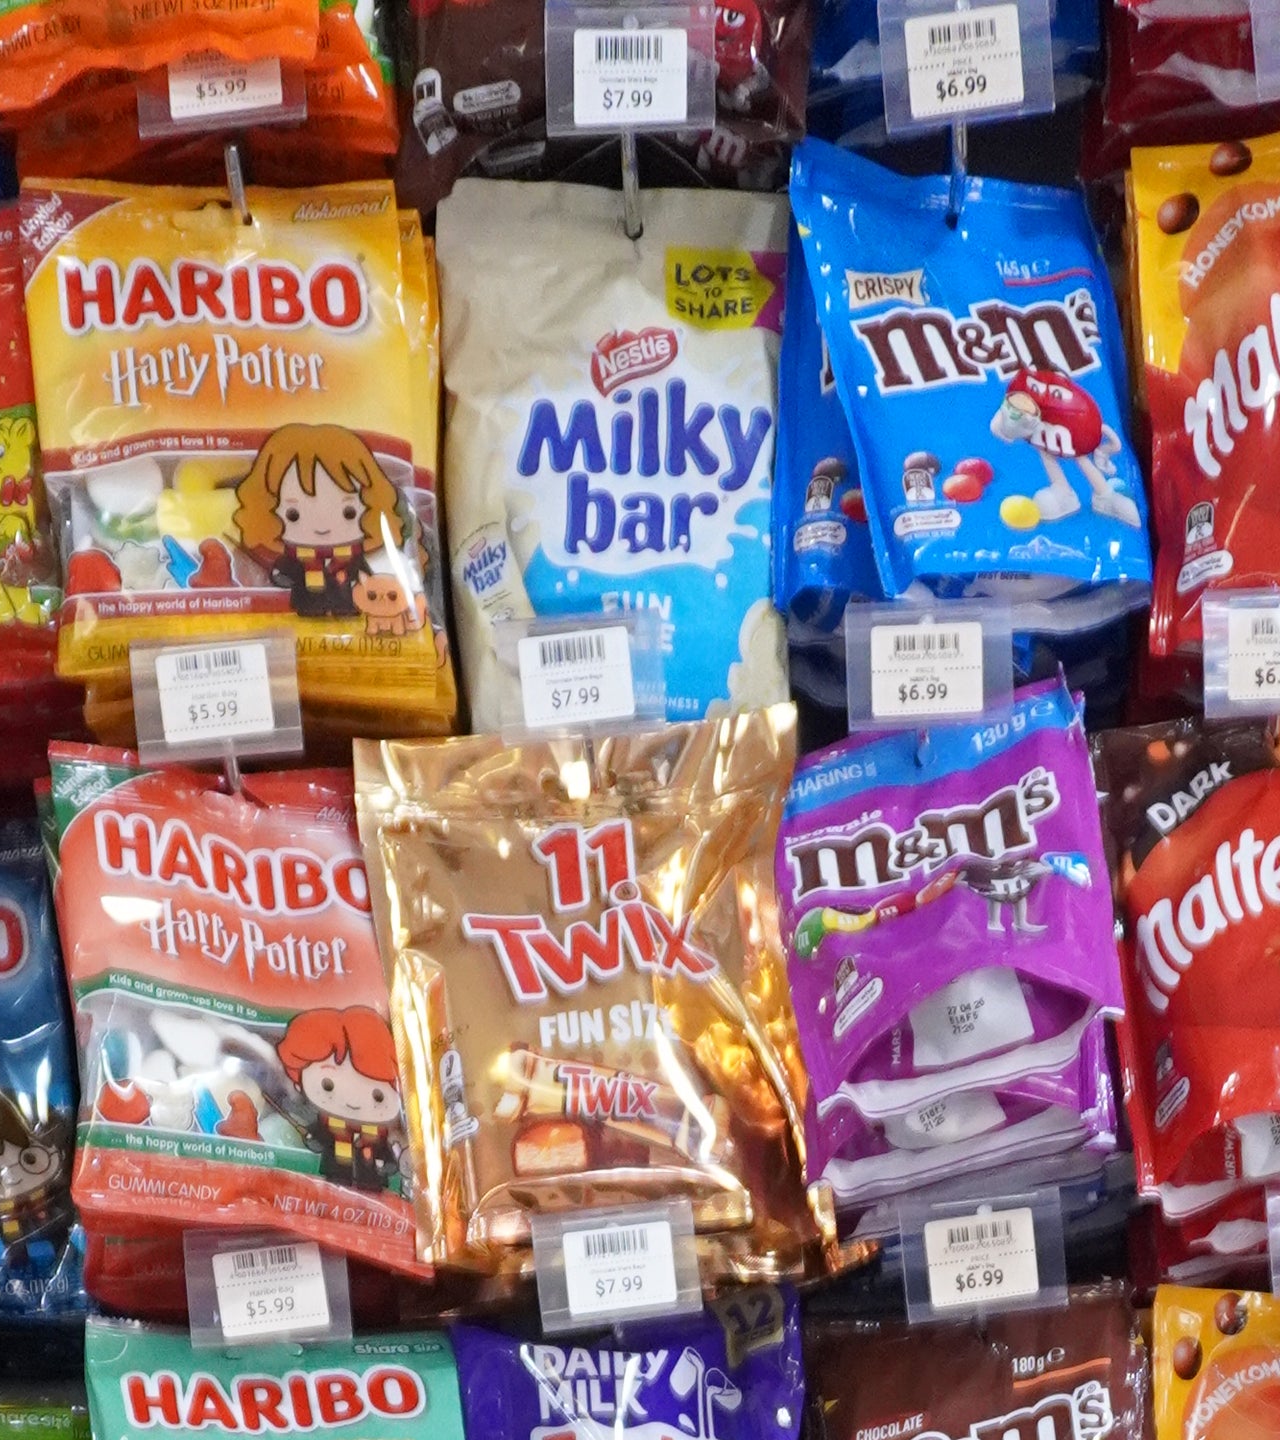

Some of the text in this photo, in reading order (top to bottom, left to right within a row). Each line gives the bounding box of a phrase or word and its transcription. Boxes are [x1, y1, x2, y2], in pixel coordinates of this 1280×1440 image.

[936, 76, 987, 97] $6.99
[675, 264, 750, 285] LOTS
[703, 284, 722, 298] TO
[854, 276, 915, 300] CRISPY
[60, 257, 369, 333] HARIBO
[675, 295, 754, 321] SHARE
[113, 335, 325, 404] Harry Potter
[517, 380, 774, 491] Milky
[564, 471, 719, 557] bar
[188, 700, 239, 720] $5.99
[1145, 759, 1232, 837] DARK
[533, 824, 631, 909] 11
[465, 881, 717, 1002] Twix
[539, 1009, 603, 1049] FUN
[108, 1175, 221, 1199] GUMMI CANDY
[273, 1195, 302, 1212] NET
[305, 1200, 327, 1216] WT
[330, 1204, 339, 1219] 4
[342, 1206, 364, 1222] OZ
[594, 1275, 643, 1296] $7.99
[125, 1367, 421, 1434] HARIBO
